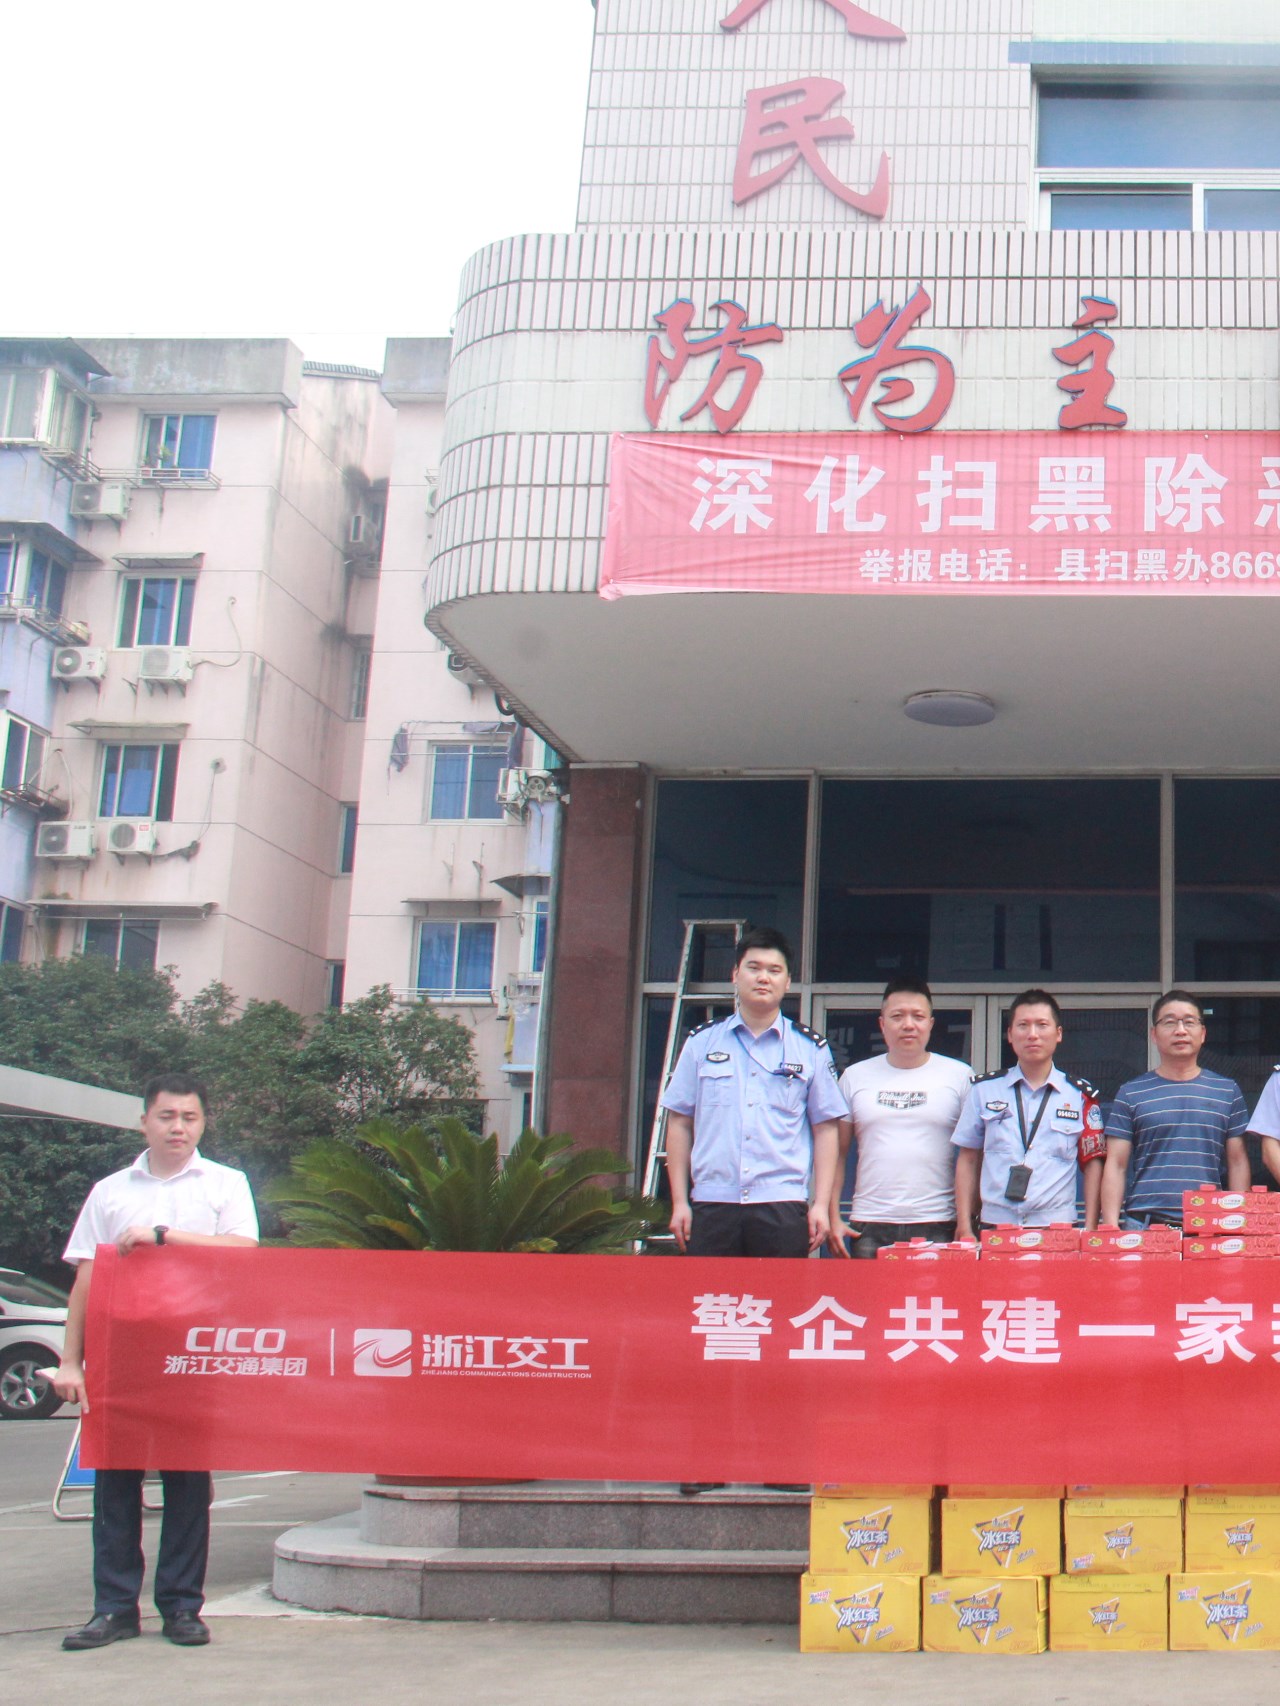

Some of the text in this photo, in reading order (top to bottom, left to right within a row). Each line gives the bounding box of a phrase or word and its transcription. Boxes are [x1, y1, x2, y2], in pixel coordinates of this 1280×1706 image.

[185, 1327, 287, 1354] CICO
[422, 1335, 590, 1371] 浙江交工
[163, 1356, 307, 1377] 浙江交通集团
[459, 1370, 530, 1378] COMMUNICATIONS
[530, 1371, 592, 1379] CONSTRUCTION
